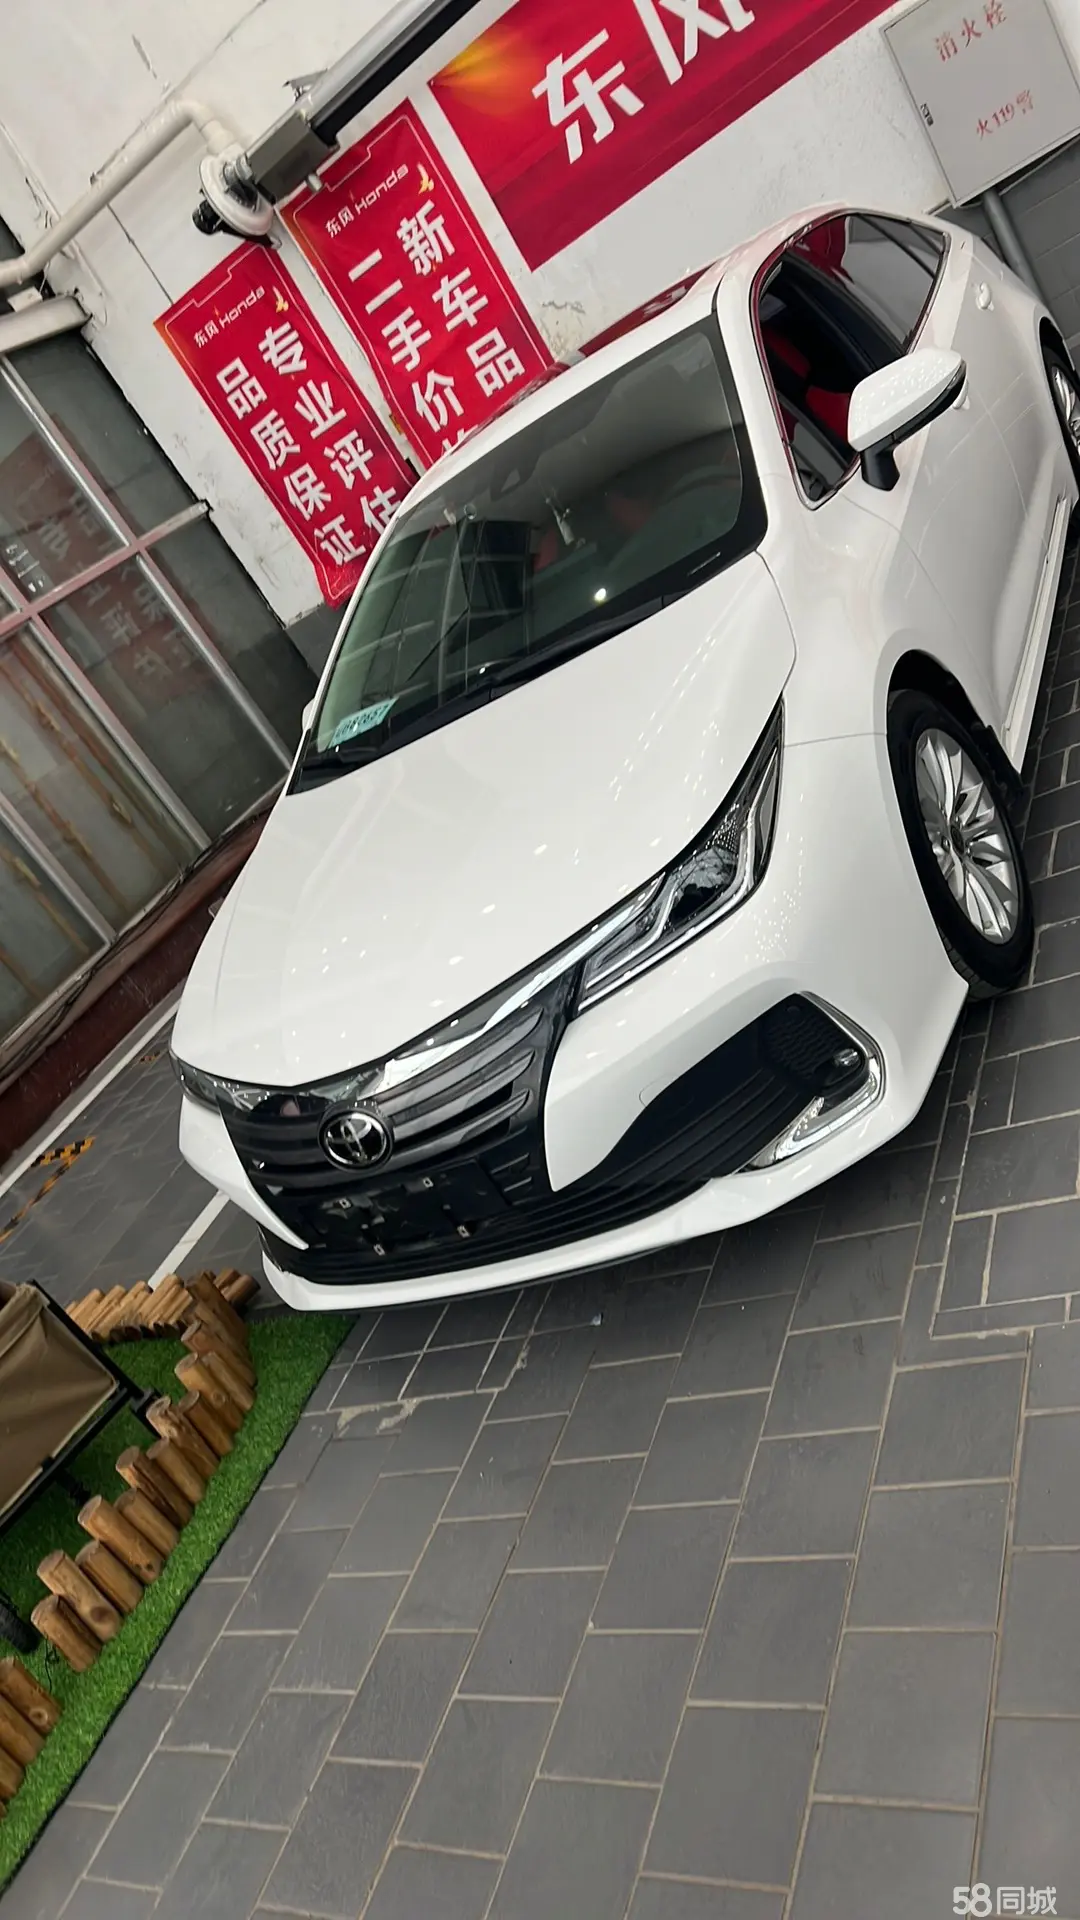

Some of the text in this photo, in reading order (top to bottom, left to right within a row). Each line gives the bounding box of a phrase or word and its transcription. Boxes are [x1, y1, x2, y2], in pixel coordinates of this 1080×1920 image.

[325, 163, 409, 238] 东风 Honda
[193, 285, 266, 349] 东风 Honda
[348, 248, 478, 455] 二手价
[215, 357, 366, 566] 品质保证
